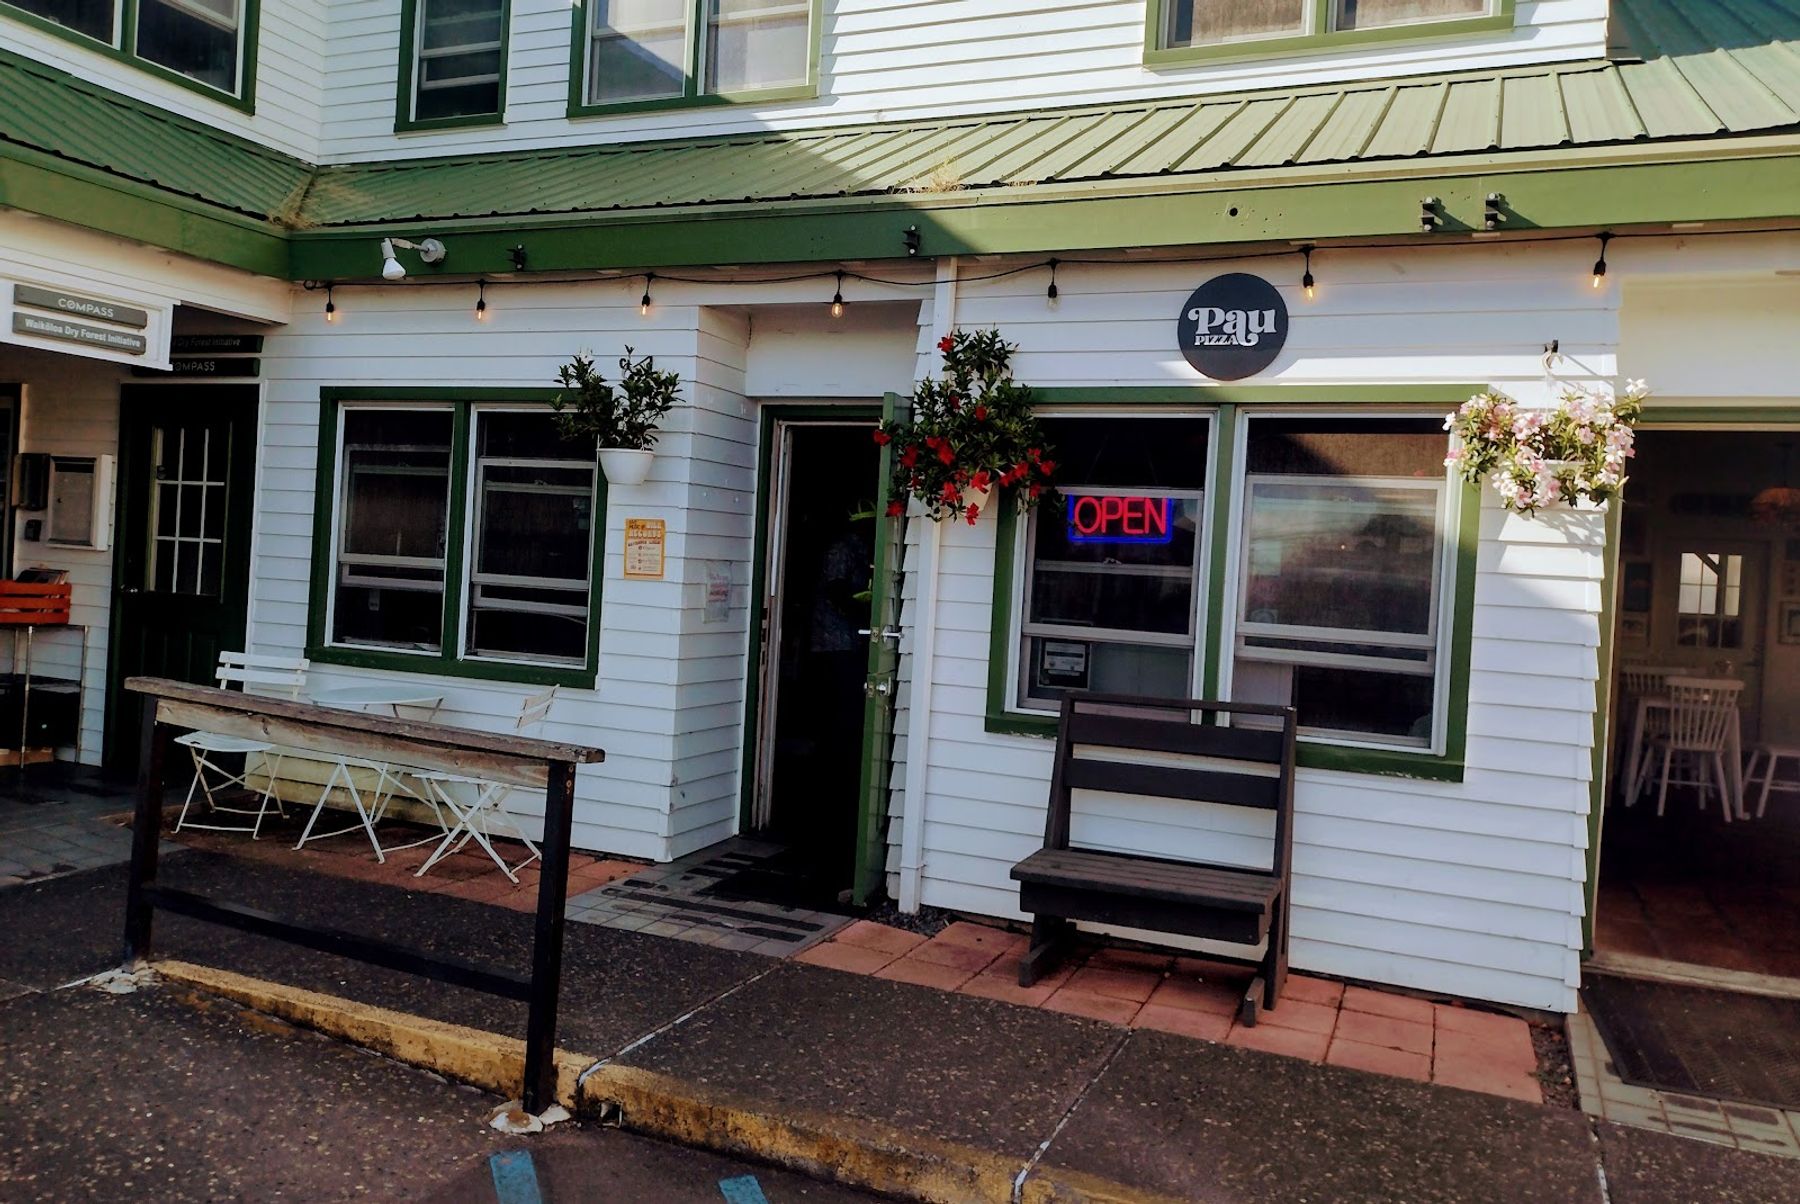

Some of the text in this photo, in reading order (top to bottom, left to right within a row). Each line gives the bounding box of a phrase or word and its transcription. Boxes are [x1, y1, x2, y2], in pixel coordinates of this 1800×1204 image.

[58, 298, 114, 318] COMPASS
[65, 326, 79, 338] Dry
[81, 329, 106, 342] Forest
[108, 334, 141, 348] Initiative
[1187, 307, 1277, 347] Pau
[1194, 334, 1238, 346] PIZZA
[172, 361, 215, 372] OMPASS
[1074, 496, 1168, 535] OPEN
